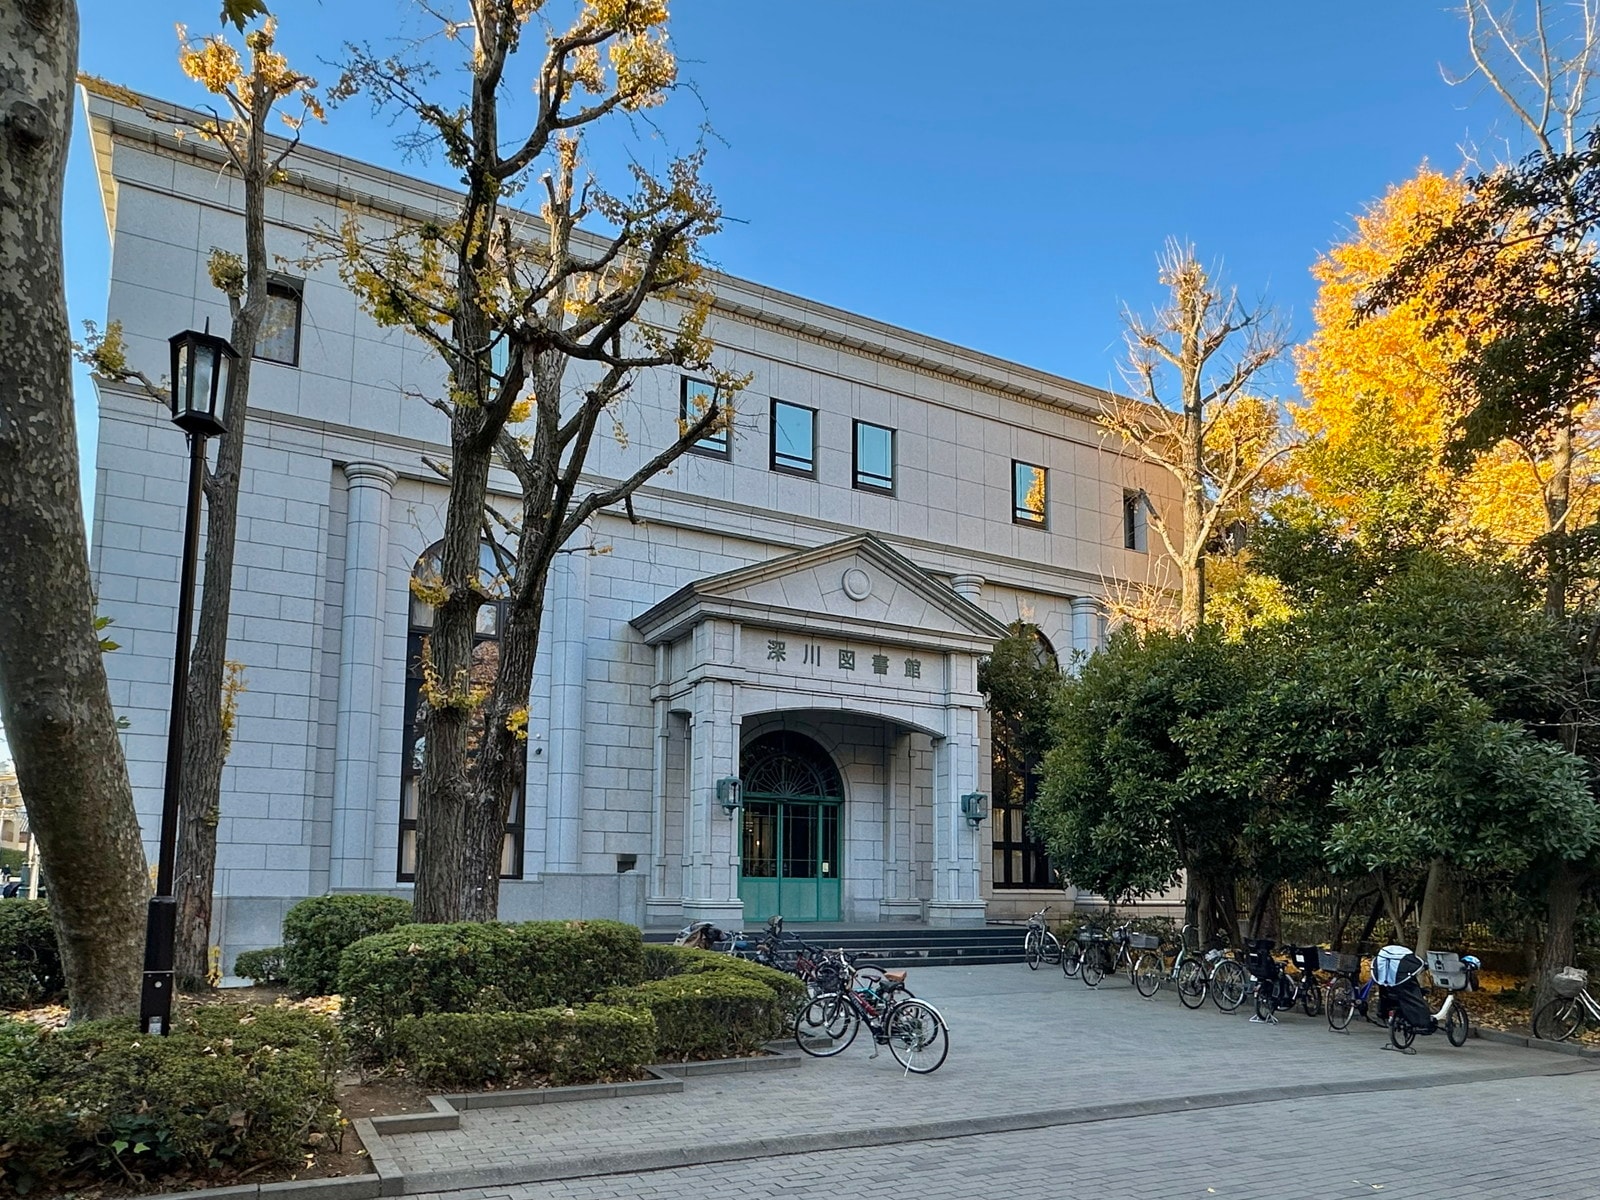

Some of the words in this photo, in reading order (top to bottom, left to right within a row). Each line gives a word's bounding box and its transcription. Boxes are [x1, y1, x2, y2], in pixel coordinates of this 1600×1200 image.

[767, 639, 922, 680] 深川図書館
